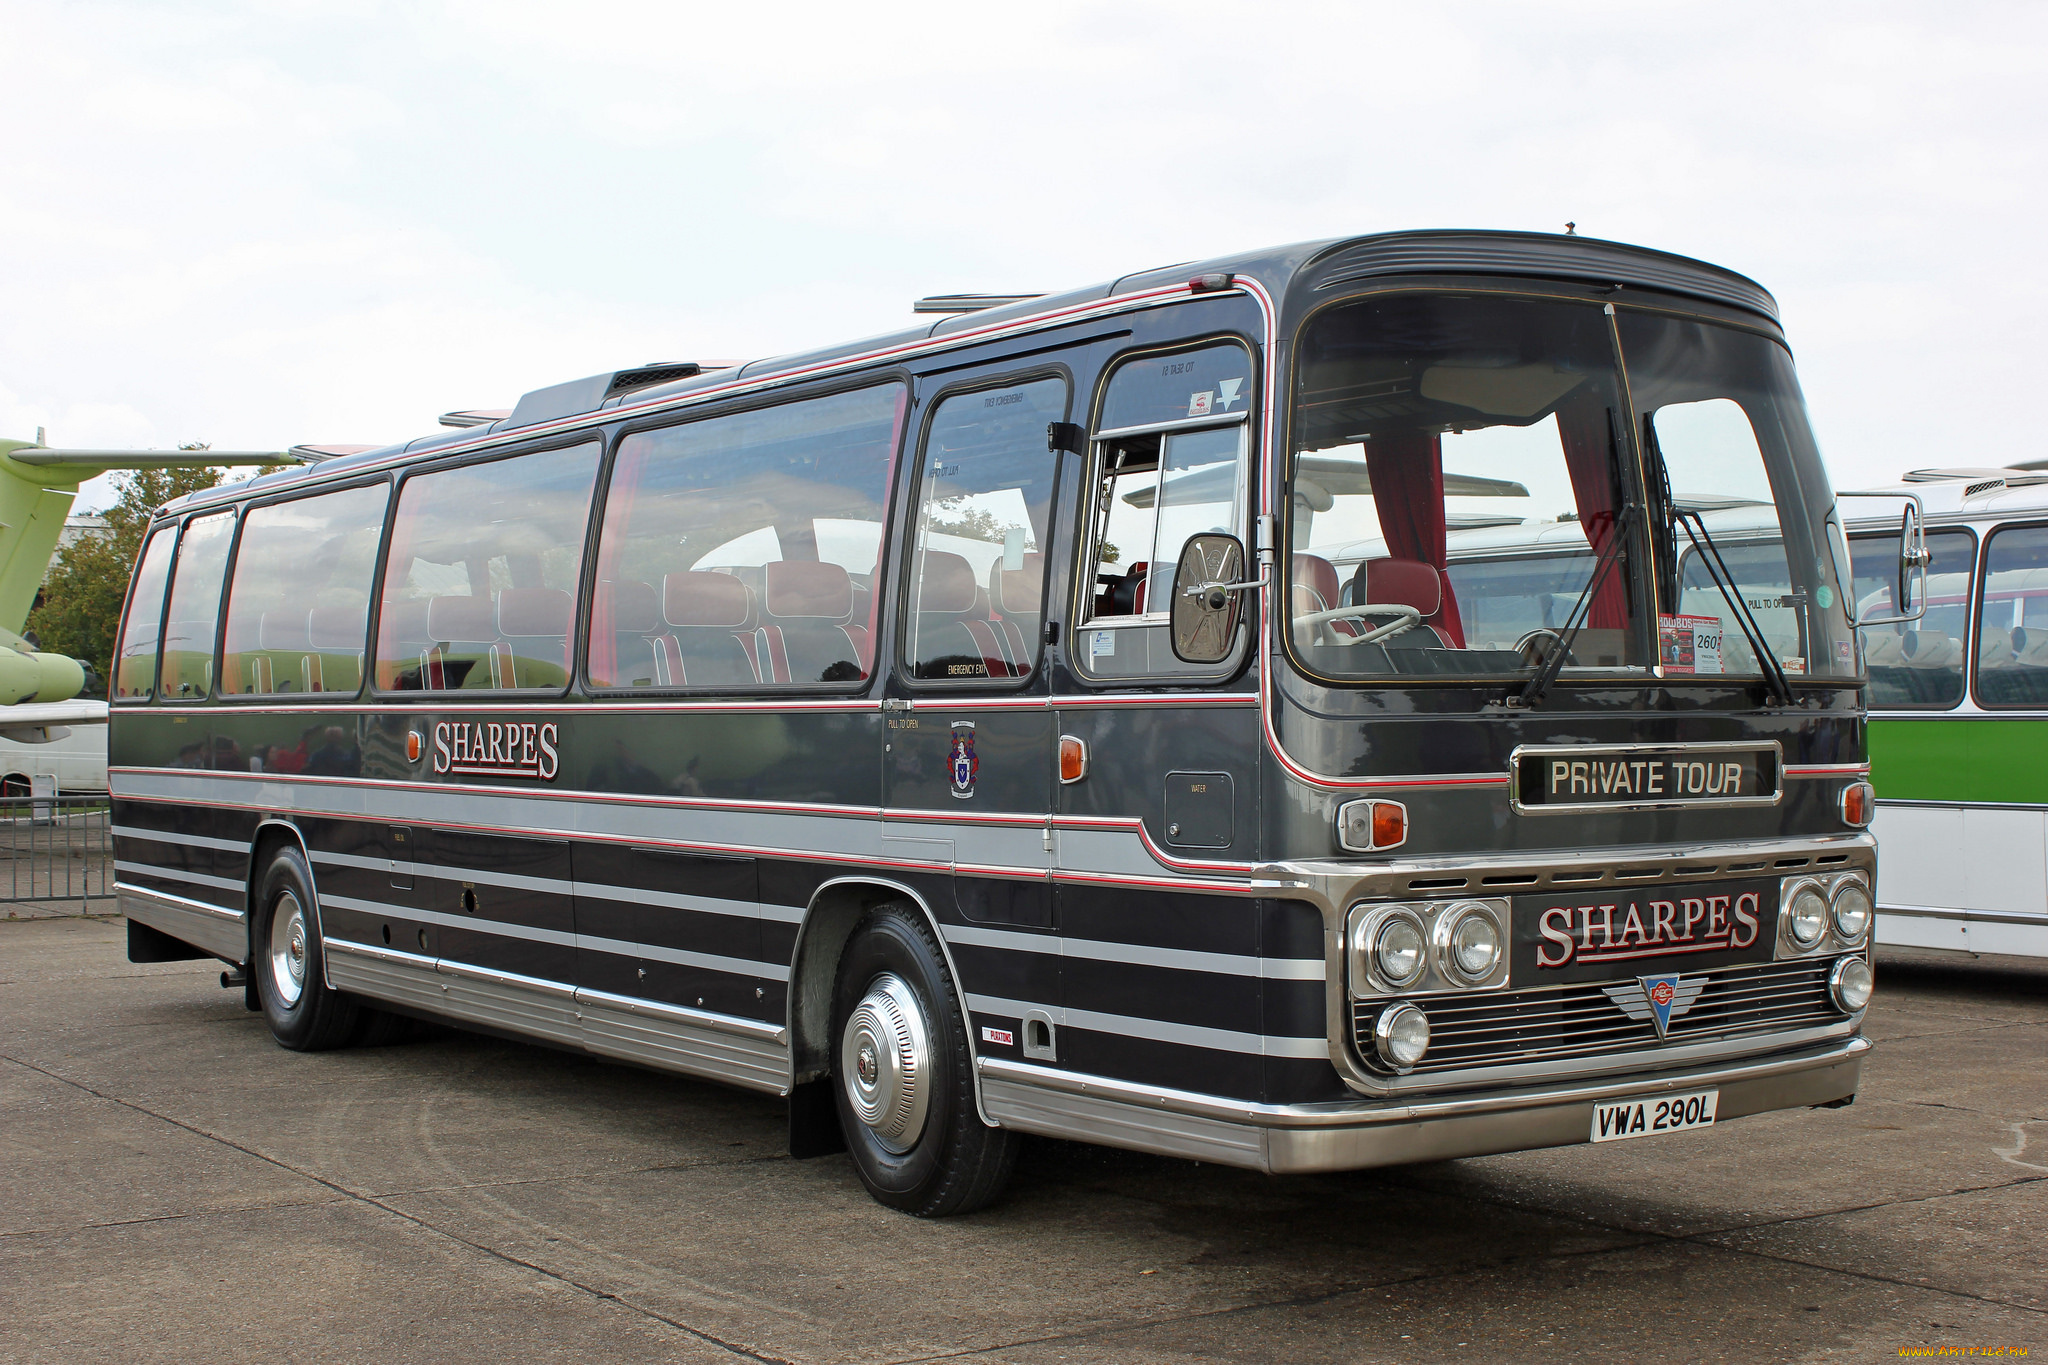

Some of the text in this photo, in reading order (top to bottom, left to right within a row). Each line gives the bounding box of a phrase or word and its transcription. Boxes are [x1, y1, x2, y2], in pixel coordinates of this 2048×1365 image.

[1748, 599, 1785, 609] PULL TO OPE
[1659, 616, 1694, 629] HOWBUS
[1697, 634, 1717, 650] 260
[948, 664, 975, 675] EMERGENCY
[888, 719, 919, 729] PULL TO OPEN
[434, 721, 559, 780] SHARPES
[1551, 761, 1742, 794] PRIVATE TOUR
[1190, 784, 1207, 793] WATER
[1536, 892, 1761, 967] SHARPES
[1654, 987, 1672, 998] AEC
[1599, 1095, 1715, 1137] VWA 290L
